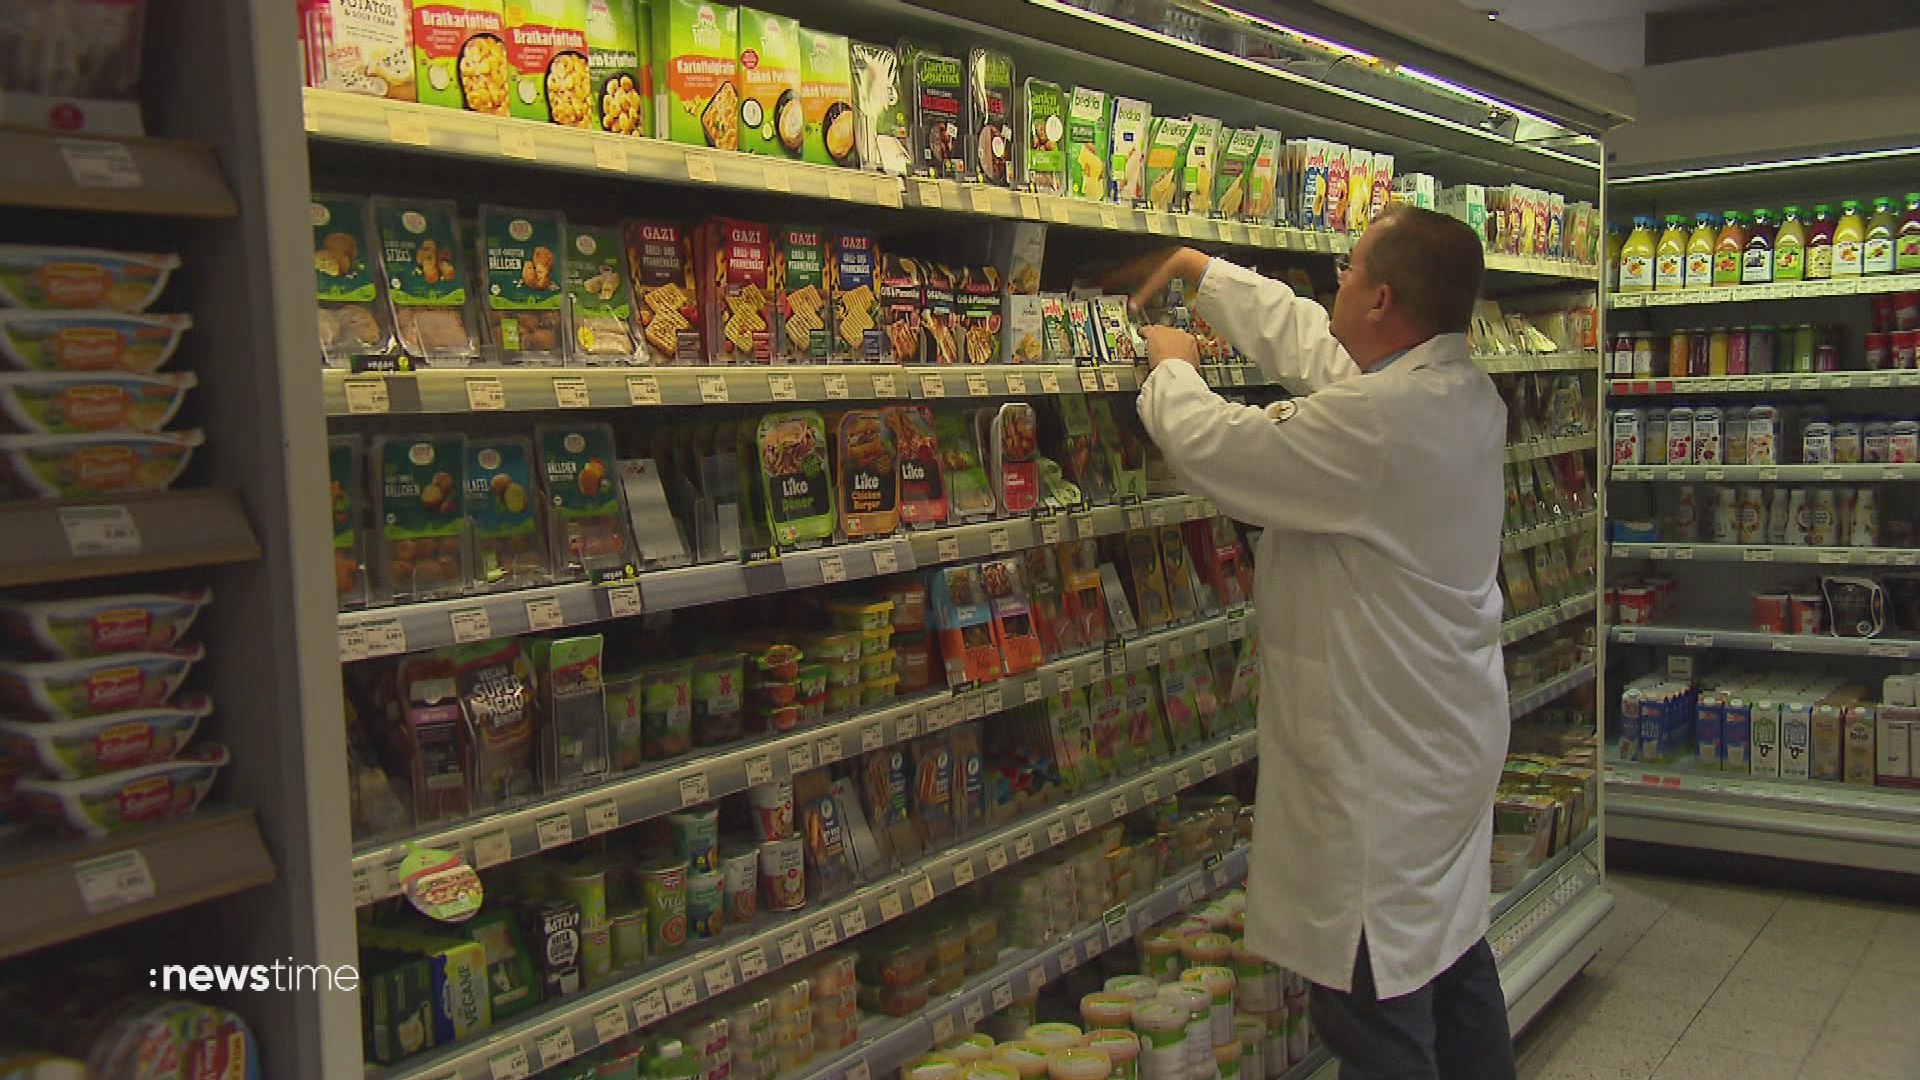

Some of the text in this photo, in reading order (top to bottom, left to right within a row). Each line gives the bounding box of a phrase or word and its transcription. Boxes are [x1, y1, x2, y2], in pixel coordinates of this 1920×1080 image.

[421, 10, 500, 30] Bratkartoffeln
[513, 28, 584, 47] Bratkartoffeln
[643, 226, 675, 241] GAZI
[732, 228, 761, 243] GAZI
[789, 232, 817, 246] GAZI
[842, 236, 867, 250] GAZI
[473, 675, 523, 700] SUPER
[457, 964, 479, 1028] VEGANE
